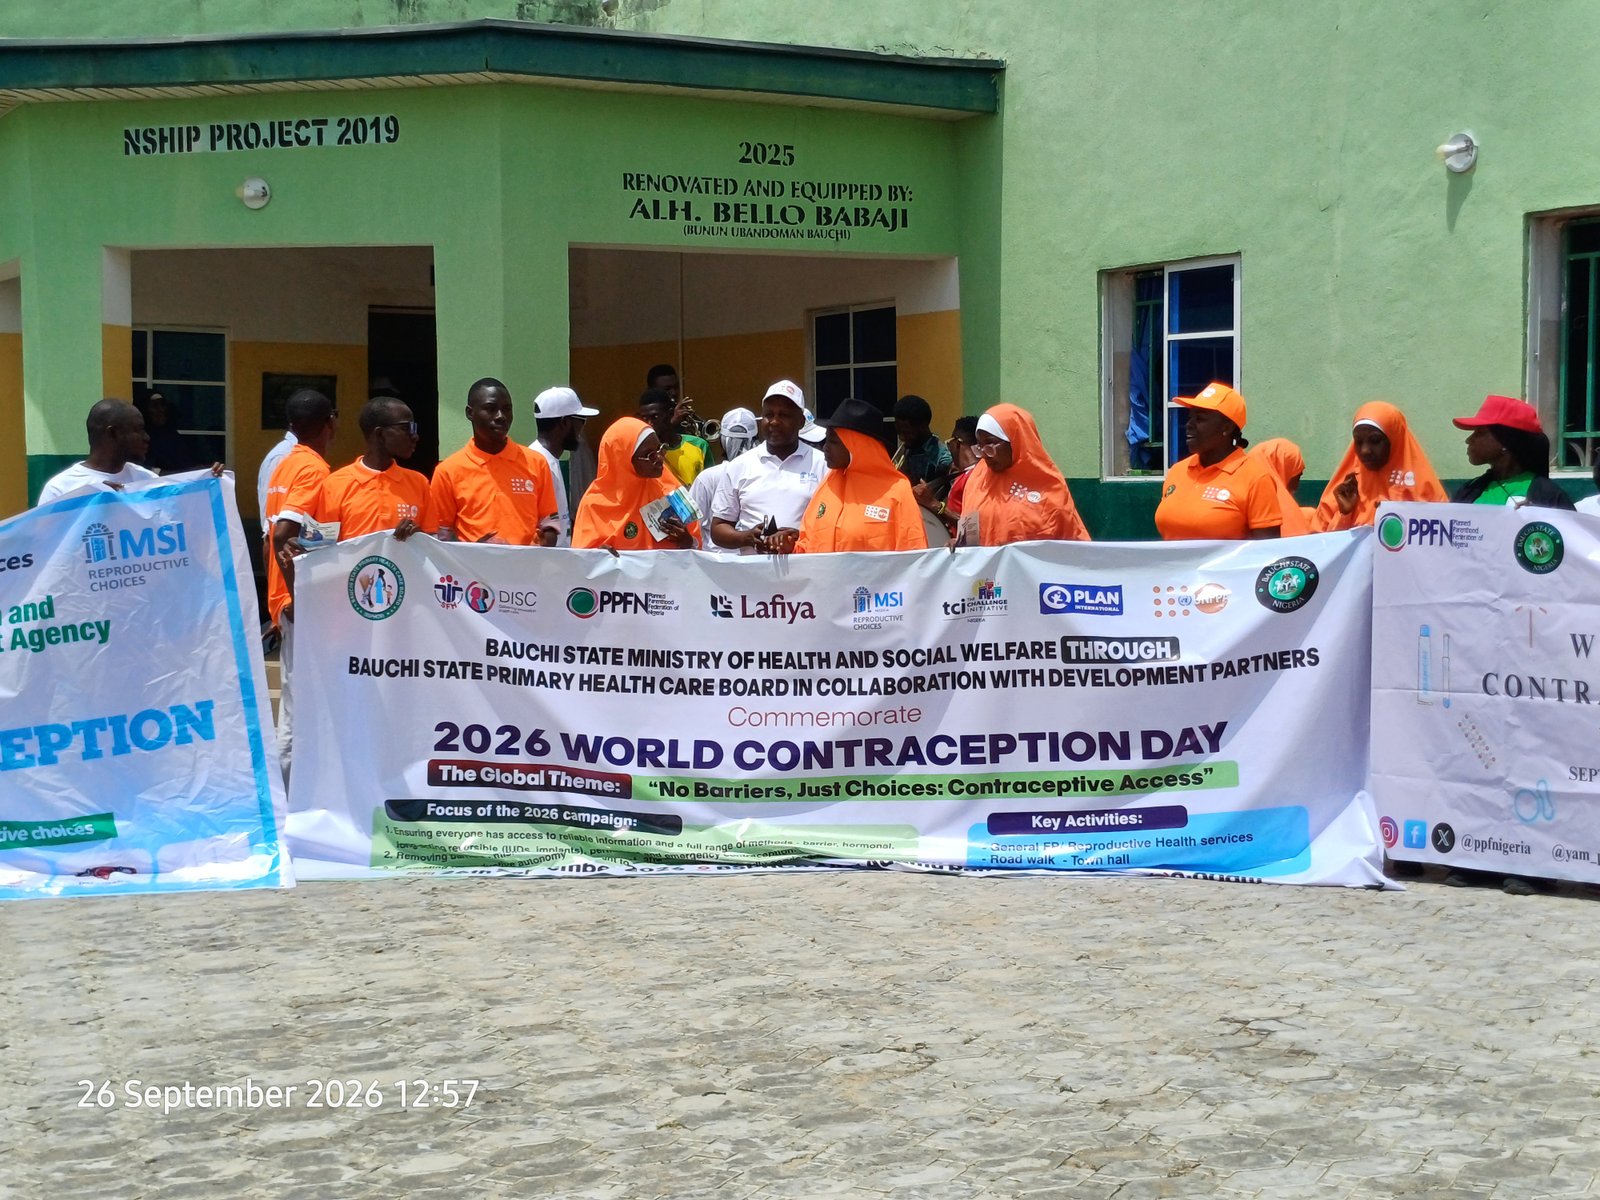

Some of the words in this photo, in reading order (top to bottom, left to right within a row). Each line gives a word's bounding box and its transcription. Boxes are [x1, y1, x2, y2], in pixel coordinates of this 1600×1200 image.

[124, 126, 201, 155] NSHIP
[209, 119, 328, 151] PROJECT
[337, 115, 400, 146] 2019
[739, 141, 795, 166] 2025
[622, 173, 738, 196] RENOVATED
[743, 179, 785, 197] AND
[791, 181, 882, 203] EQUIPPED
[888, 185, 913, 202] BY:
[629, 198, 701, 221] ALH.
[713, 202, 806, 225] BELLO
[815, 206, 908, 232] BABAJI
[683, 225, 728, 238] (BUNUN
[731, 227, 805, 240] UBANDOMAN
[806, 228, 851, 241] BAUCHI)
[119, 523, 187, 560] MSI
[1408, 519, 1454, 547] PPFN
[89, 557, 190, 580] REPRODUCTIVE
[1290, 560, 1311, 572] STATE
[90, 575, 147, 592] CHOICES
[499, 590, 537, 607] DISC
[600, 591, 649, 616] PPFN
[874, 591, 903, 608] MSI
[942, 598, 966, 616] tci
[967, 600, 1008, 608] CHALLENGE
[1074, 589, 1120, 605] PLAN
[1074, 604, 1120, 612] INTERNATIONAL
[1272, 597, 1305, 609] NIGERIA
[9, 595, 55, 624] and
[741, 594, 817, 625] Lafiya
[853, 615, 904, 624] REPRODUCTIVE
[967, 605, 1009, 613] INITIATIVE
[10, 619, 111, 653] Agency
[853, 623, 882, 631] CHOICES
[485, 638, 560, 663] BAUCHI
[563, 645, 624, 666] STATE
[627, 648, 724, 670] MINISTRY
[727, 651, 755, 670] OF
[758, 651, 831, 670] HEALTH
[835, 650, 879, 669] AND
[882, 644, 957, 668] SOCIAL
[960, 641, 1057, 661] WELFARE
[1066, 640, 1171, 661] THROUGH
[1569, 633, 1595, 659] W
[348, 656, 420, 678] BAUCHI
[423, 659, 484, 680] STATE
[486, 664, 575, 691] PRIMARY
[578, 673, 656, 695] HEALTH
[658, 676, 715, 696] CARE
[718, 677, 790, 697] BOARD
[792, 678, 813, 697] IN
[815, 671, 987, 697] COLLABORATION
[988, 668, 1045, 688] WITH
[1048, 664, 1209, 687] DEVELOPMENT
[1211, 647, 1320, 681] PARTNERS
[1482, 672, 1600, 705] CONTR
[728, 705, 922, 727] Commemorate
[433, 721, 551, 757] 2026
[560, 732, 724, 770] WORLD
[732, 730, 1131, 772] CONTRACEPTION
[1141, 721, 1229, 761] DAY
[438, 765, 477, 783] The
[480, 765, 545, 786] Global
[548, 770, 621, 794] Theme:
[648, 780, 690, 798] “No
[694, 782, 792, 800] Barriers,
[797, 782, 842, 798] Just
[845, 779, 944, 798] Choices:
[948, 775, 1115, 797] Contraceptive
[1119, 767, 1214, 791] Access”
[426, 803, 473, 817] Focus
[476, 803, 492, 817] of
[495, 804, 521, 817] the
[524, 806, 559, 820] 2026
[563, 810, 638, 828] campaign:
[1031, 815, 1061, 831] Key
[1065, 813, 1143, 828] Activities:
[32, 824, 95, 840] choices
[394, 826, 433, 840] Ensuring
[435, 829, 484, 840] everyone
[486, 830, 505, 839] has
[507, 831, 544, 840] access
[546, 831, 557, 840] to
[559, 833, 594, 843] reliable
[595, 836, 652, 848] information
[655, 840, 674, 848] and
[705, 844, 733, 853] range
[736, 841, 746, 849] of
[1155, 836, 1197, 848] Health
[1200, 832, 1254, 847] services
[1461, 834, 1531, 855] @ppfnigeria
[384, 850, 393, 859] 2.
[396, 851, 448, 863] Removing
[990, 854, 1023, 864] Road
[1027, 854, 1056, 865] walk
[1071, 855, 1103, 866] Town
[1107, 853, 1130, 865] hall
